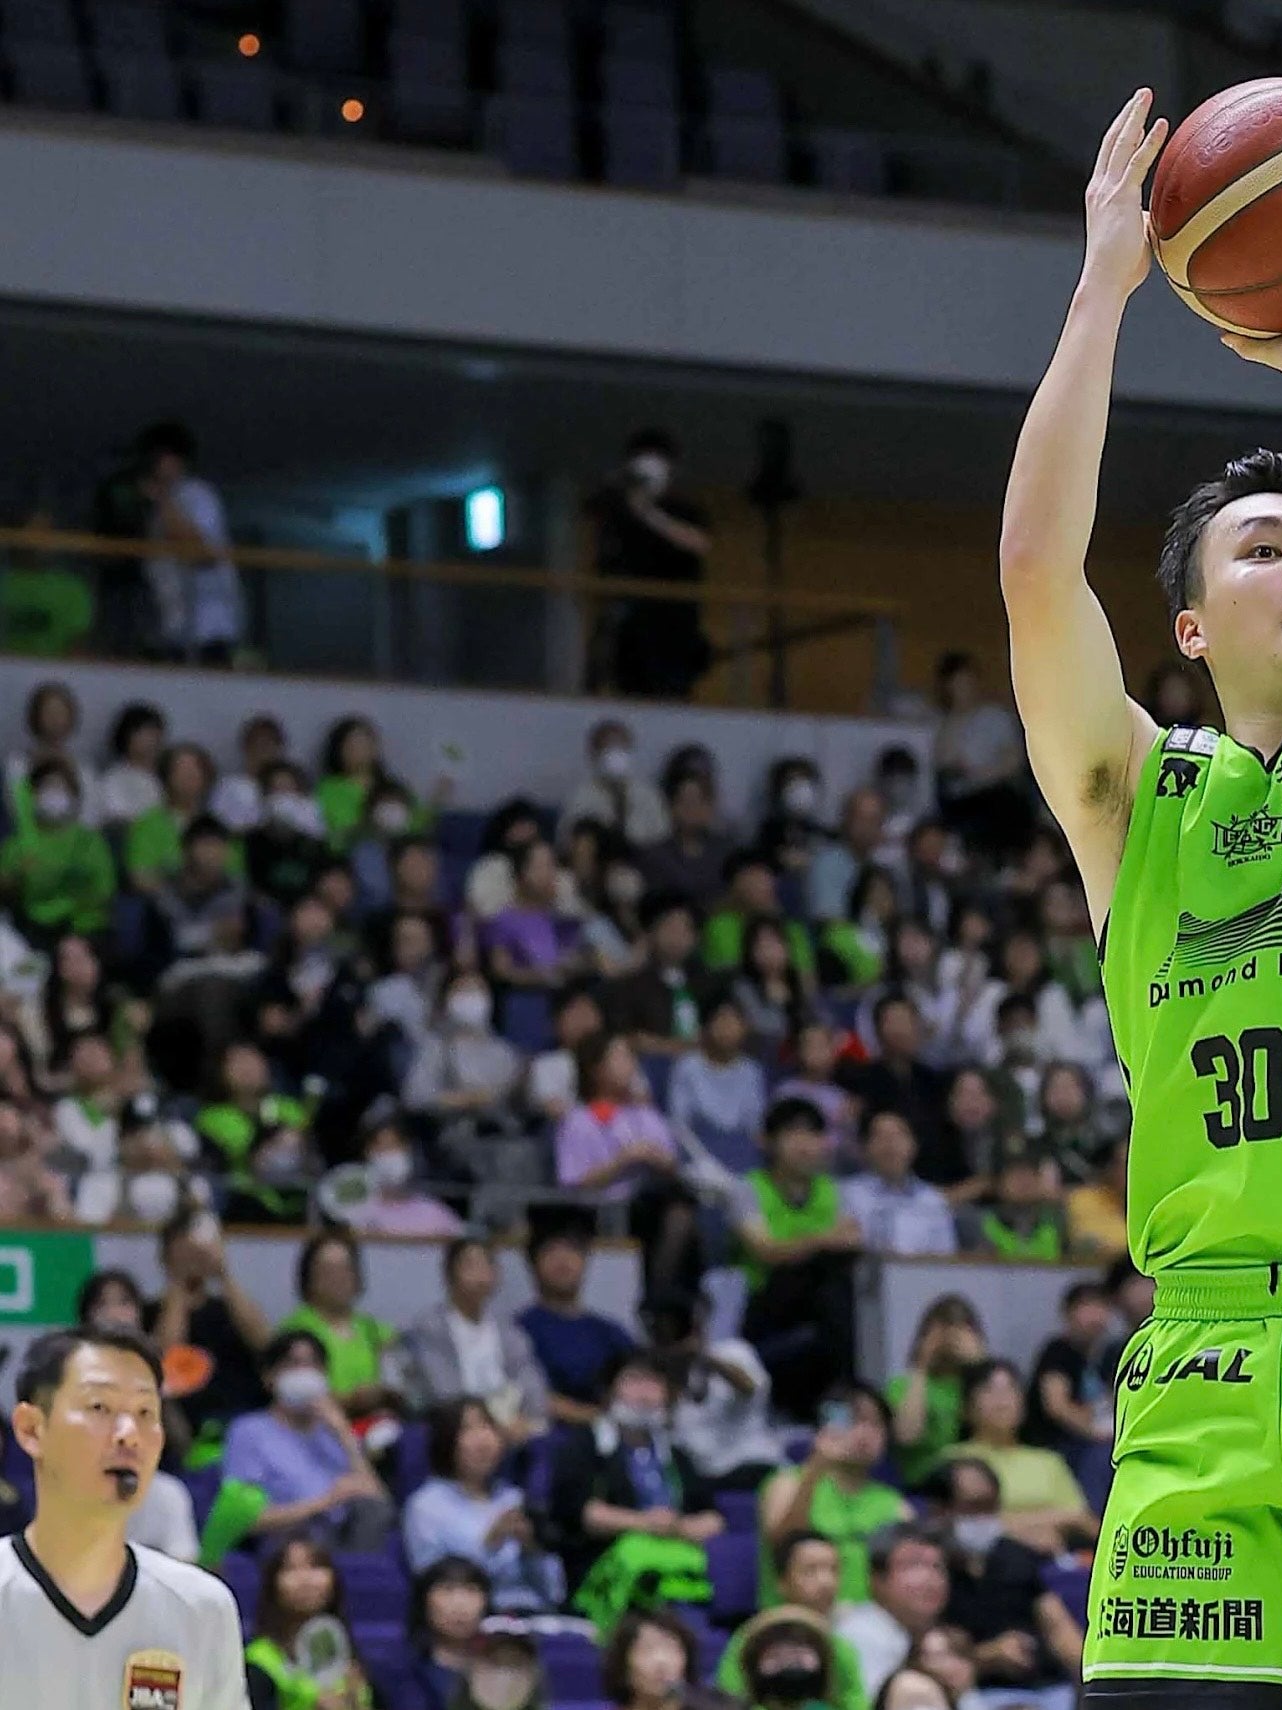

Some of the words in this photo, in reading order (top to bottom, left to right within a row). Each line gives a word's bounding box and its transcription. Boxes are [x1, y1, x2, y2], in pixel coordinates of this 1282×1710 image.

[1150, 957, 1257, 1007] Dmond
[1154, 1348, 1254, 1383] JAL
[1132, 1525, 1235, 1566] Ohfuji
[1133, 1566, 1195, 1580] EDUCATION
[1197, 1567, 1232, 1581] GROUP
